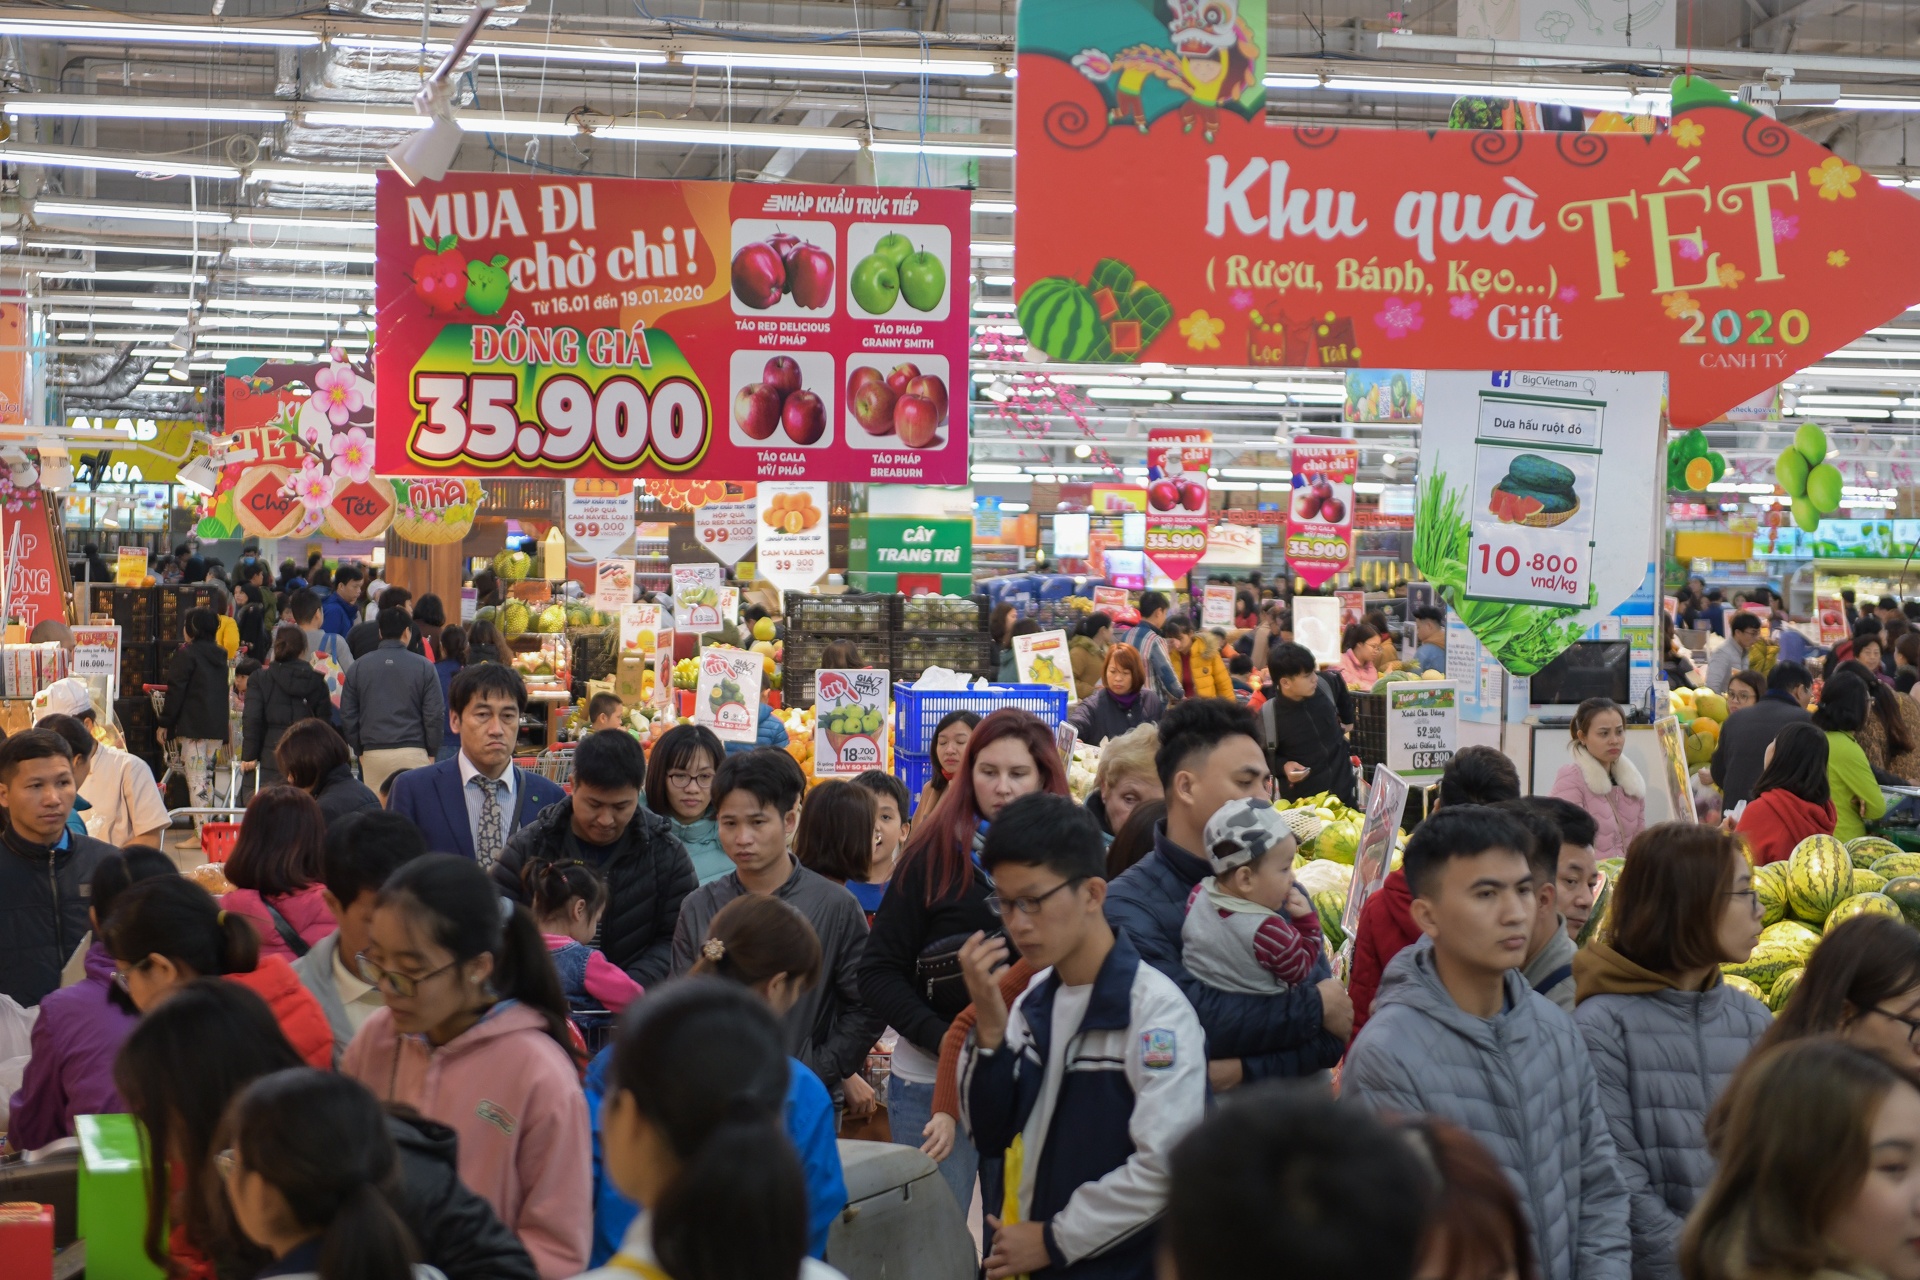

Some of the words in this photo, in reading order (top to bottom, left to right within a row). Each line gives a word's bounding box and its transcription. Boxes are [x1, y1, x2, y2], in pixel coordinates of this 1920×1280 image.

[773, 192, 813, 217] NHẬP
[815, 187, 855, 214] KHẨU
[856, 194, 889, 219] TRỰC
[891, 191, 920, 216] TIẾP
[1205, 154, 1368, 241] Khu
[1393, 175, 1547, 263] quà
[406, 189, 528, 245] MUA
[539, 182, 596, 235] ĐI
[1557, 155, 1800, 302] TẾT
[508, 239, 596, 293] chờ
[606, 226, 698, 281] chi!
[1335, 255, 1434, 297] Bánh,
[532, 300, 549, 316] Từ
[551, 295, 590, 314] 16.01
[596, 293, 618, 311] đến
[620, 285, 704, 308] 19.01.2020
[735, 318, 757, 331] TÁO
[757, 321, 778, 332] RED
[779, 321, 831, 333] DELICIOUS
[873, 323, 895, 335] TÁO
[895, 323, 923, 336] PHÁP
[1487, 303, 1564, 342] Gift
[1679, 308, 1811, 346] 2020
[470, 311, 580, 365] ĐỒNG
[587, 319, 653, 368] GIÁ
[758, 332, 777, 346] MỸ/
[779, 332, 807, 346] PHÁP
[862, 337, 903, 349] GRANNY
[904, 338, 934, 350] SMITH
[1699, 353, 1757, 370] CANH
[1762, 348, 1788, 370] TÝ
[1522, 375, 1578, 389] BigCVietnam
[410, 371, 709, 464] 35.900
[1494, 417, 1516, 429] Dưa
[1518, 418, 1539, 432] hấu
[1541, 423, 1565, 435] ruột
[1567, 423, 1582, 435] đỏ
[757, 450, 778, 463] TÁO
[779, 451, 806, 464] GALA
[872, 452, 893, 465] TÁO
[893, 453, 922, 466] PHÁP
[757, 463, 776, 477] MỸ/
[778, 463, 805, 477] PHÁP
[870, 466, 924, 479] BREABURN
[251, 493, 290, 515] Chợ
[341, 495, 377, 516] Tết
[902, 525, 936, 542] CÂY
[1147, 533, 1206, 549] 35.900
[877, 547, 933, 562] TRANG
[933, 545, 962, 563] TRÍ
[1289, 540, 1348, 559] 35.900
[1530, 574, 1578, 594] vnd/kg
[843, 747, 876, 762] 18.700
[1414, 751, 1450, 768] 68.900
